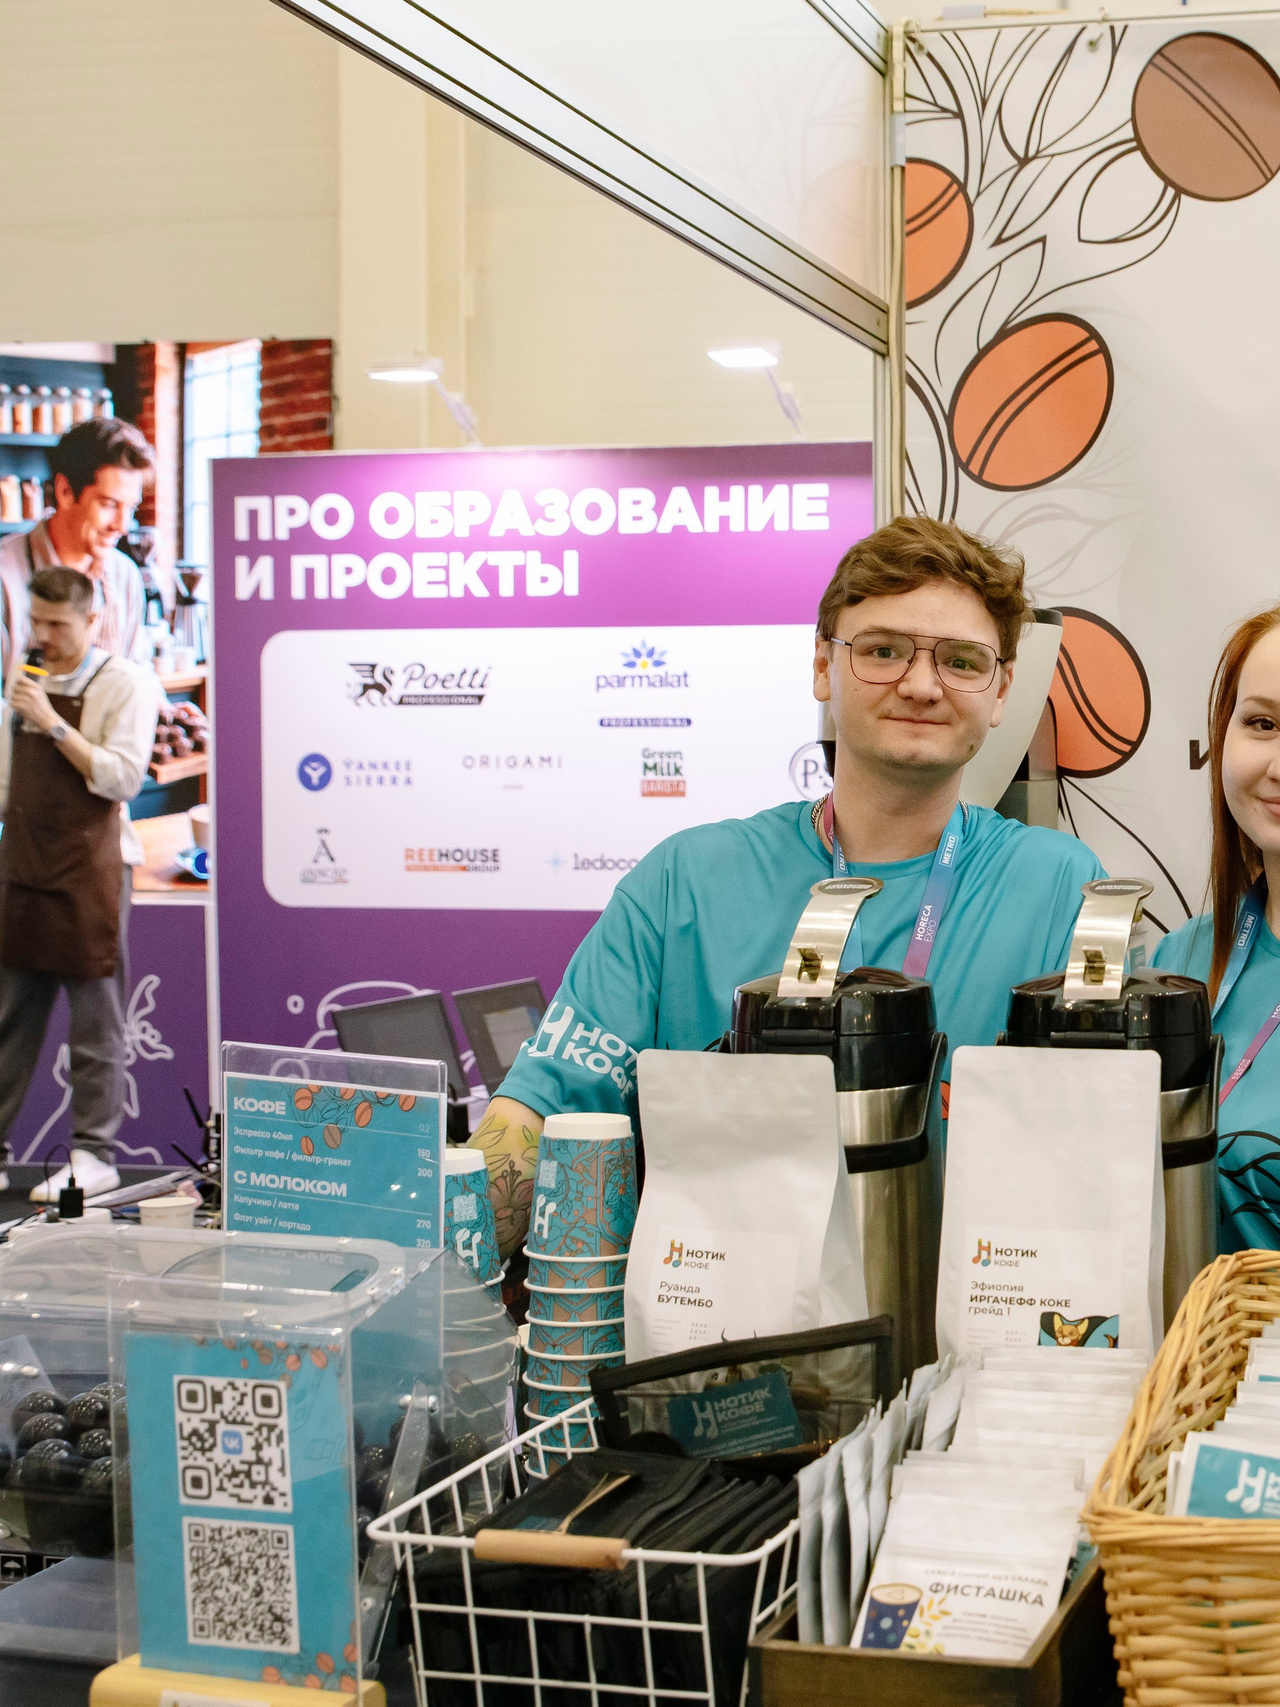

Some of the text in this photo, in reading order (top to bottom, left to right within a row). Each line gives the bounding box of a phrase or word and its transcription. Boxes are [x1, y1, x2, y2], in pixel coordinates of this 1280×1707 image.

[234, 483, 829, 542] ПРО ОБРАЗОВАНИЕ
[235, 549, 579, 600] И ПРОЕКТЫ
[403, 663, 492, 690] Poetti
[596, 671, 691, 692] parmalat
[461, 755, 564, 769] ORIGAMI
[643, 761, 683, 776] Milk
[404, 848, 500, 863] REEHOUSE
[941, 836, 957, 865] METRO
[916, 903, 932, 941] HORECA
[923, 919, 936, 942] EXPO
[1237, 914, 1255, 949] METRO
[571, 1022, 640, 1078] НОТ
[233, 1096, 286, 1116] КОФЕ
[233, 1126, 431, 1158] Эспрессо 40мл 150
[233, 1144, 264, 1158] Фильтр
[265, 1149, 286, 1161] кофе
[291, 1151, 352, 1167] фильтр-гранат
[417, 1168, 432, 1178] 200
[233, 1170, 347, 1198] С МОЛОКОМ
[233, 1194, 272, 1209] Капучино
[278, 1201, 300, 1211] латте
[416, 1219, 431, 1230] 270
[233, 1212, 253, 1224] Флэт
[254, 1215, 273, 1228] уайт
[278, 1219, 311, 1232] кортадо
[415, 1238, 431, 1249] 320
[685, 1249, 726, 1261] НОТИК
[993, 1258, 1020, 1268] КОФЕ
[994, 1247, 1038, 1259] НОТИК
[684, 1260, 710, 1270] КОФЕ
[659, 1281, 701, 1294] Руанда
[970, 1280, 1024, 1293] Эфиопия
[657, 1294, 713, 1308] БУТЕМБО
[968, 1304, 1012, 1317] грейд 1
[969, 1294, 1071, 1308] ИРГАЧЕФФ КОКЕ
[713, 1386, 772, 1411] НОТИК
[716, 1400, 765, 1423] КОФЕ
[928, 1581, 1044, 1608] ФИСТАШКА
